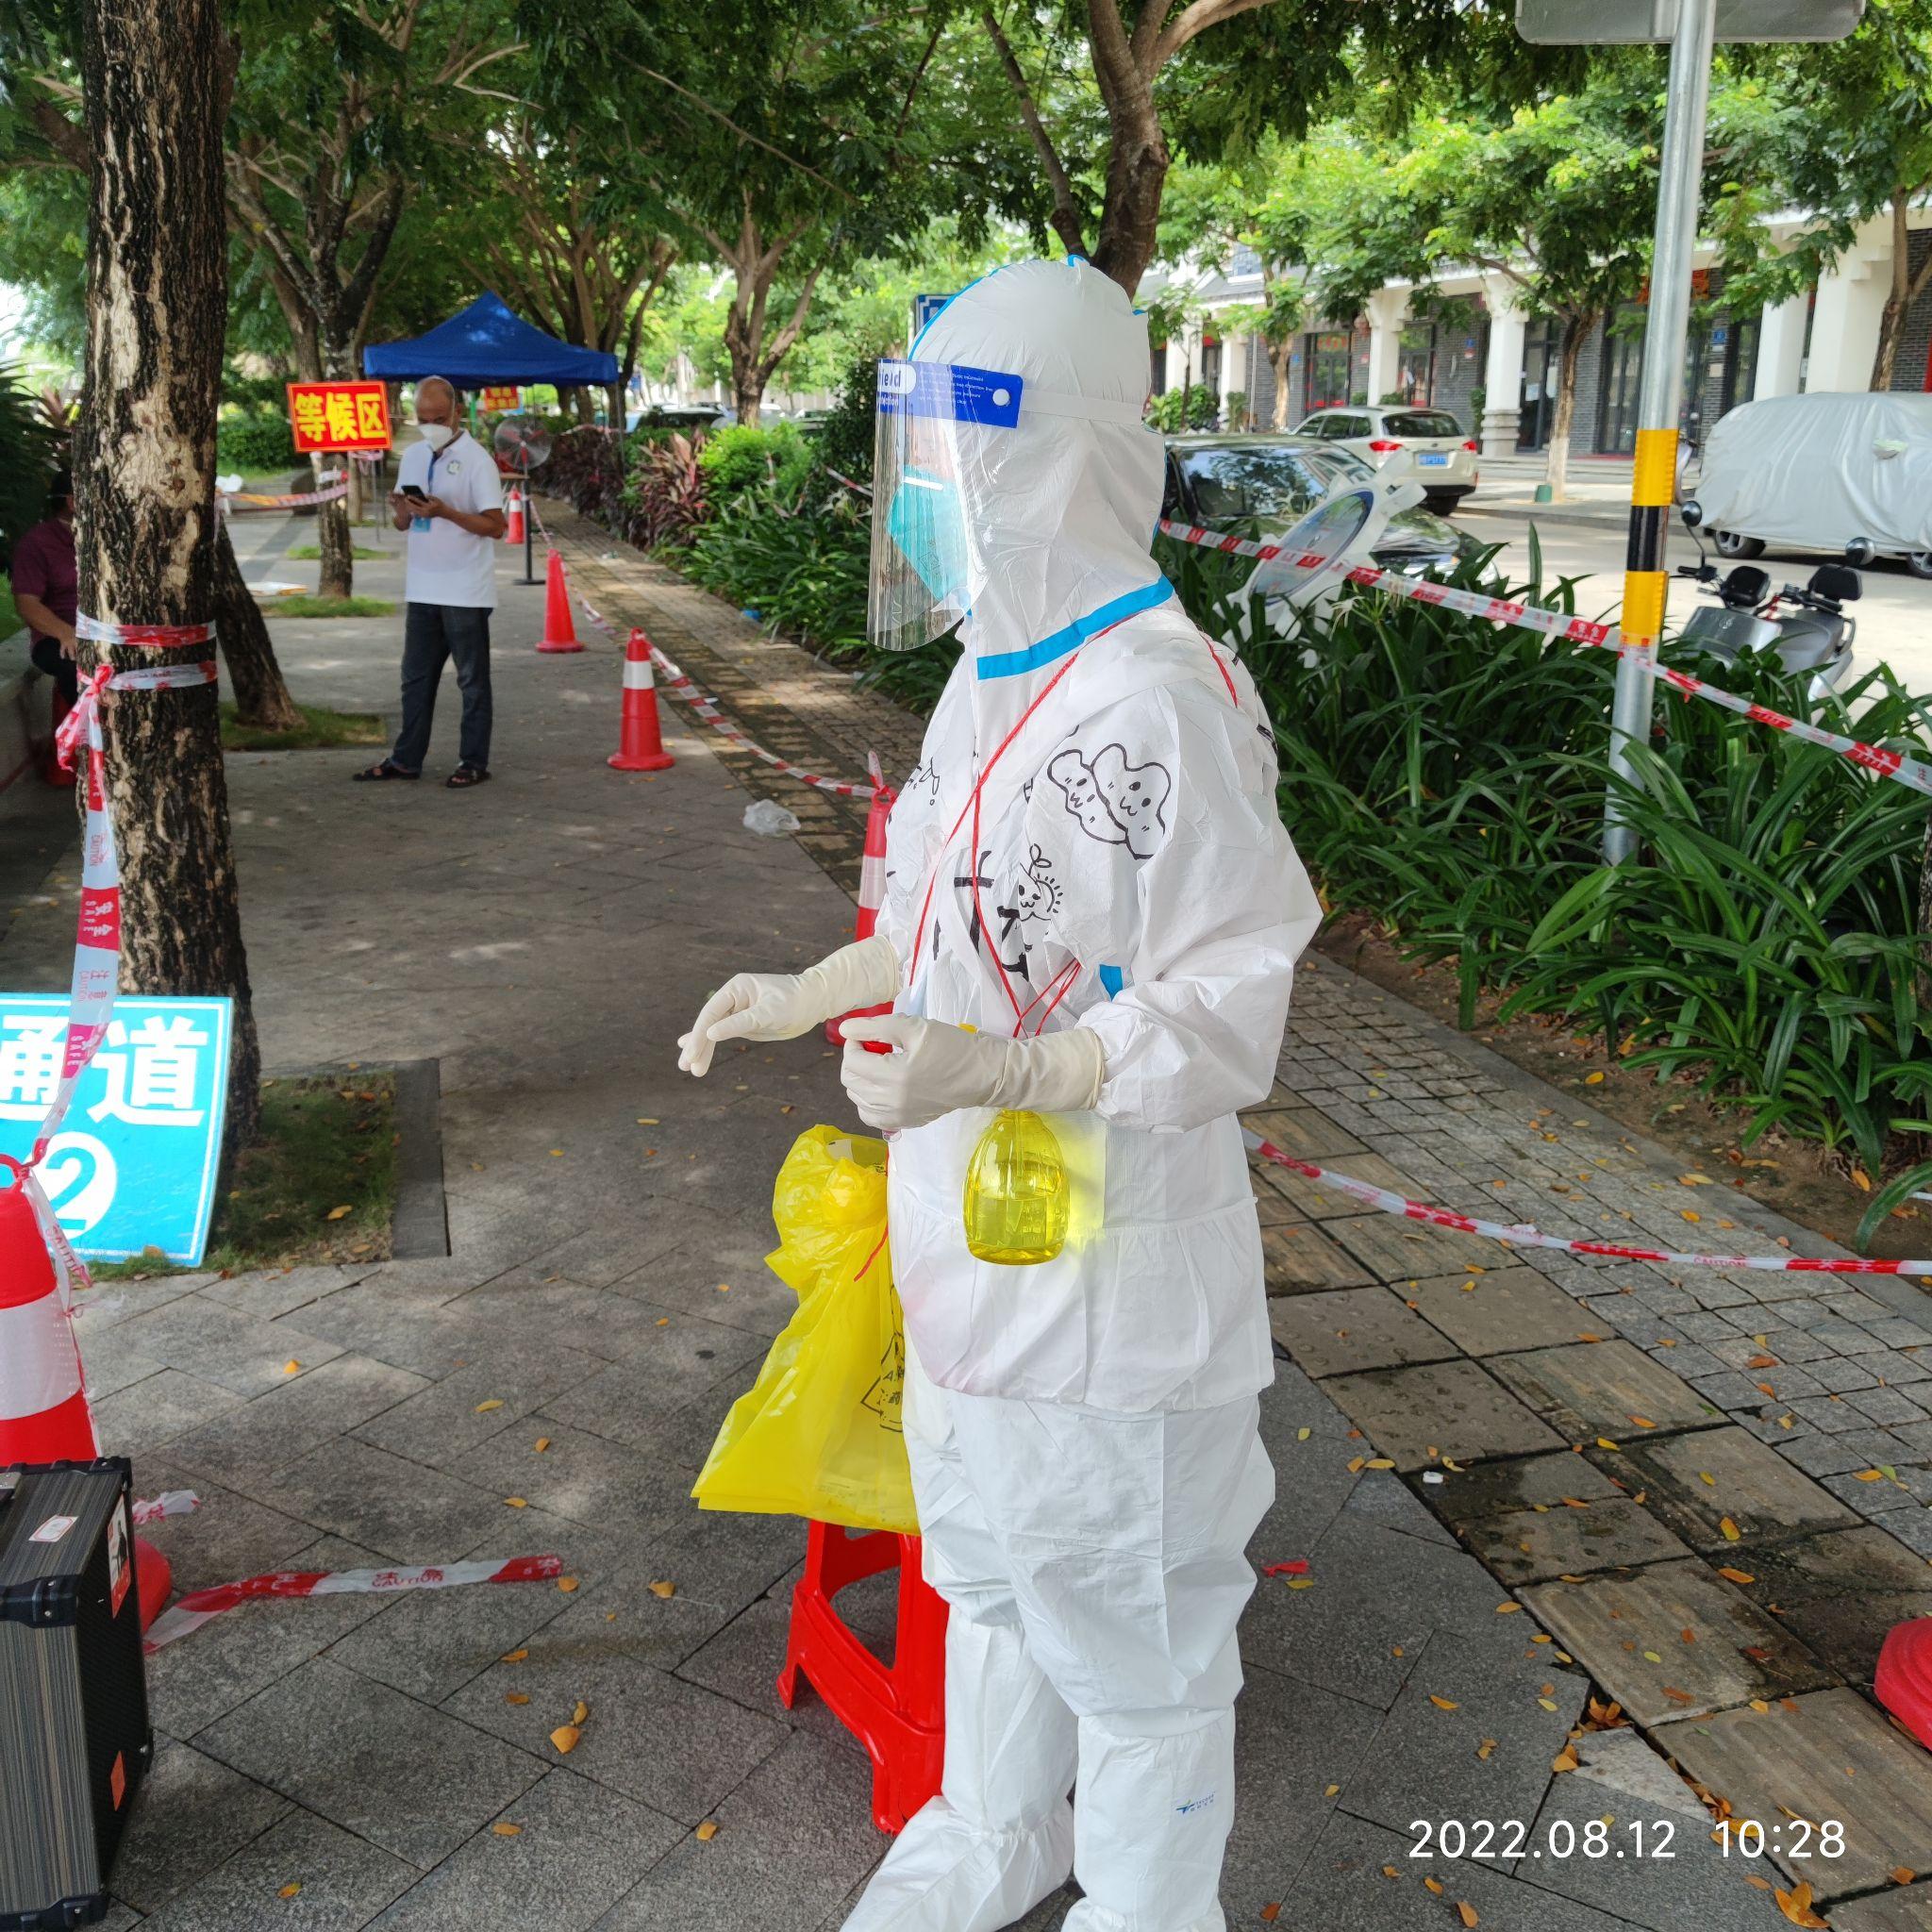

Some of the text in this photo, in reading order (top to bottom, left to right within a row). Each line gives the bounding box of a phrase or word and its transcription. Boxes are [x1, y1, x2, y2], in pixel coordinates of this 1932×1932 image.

[294, 391, 387, 441] 等候区
[83, 901, 96, 932] SAFE
[0, 1014, 208, 1127] 通道
[45, 1146, 96, 1231] 2
